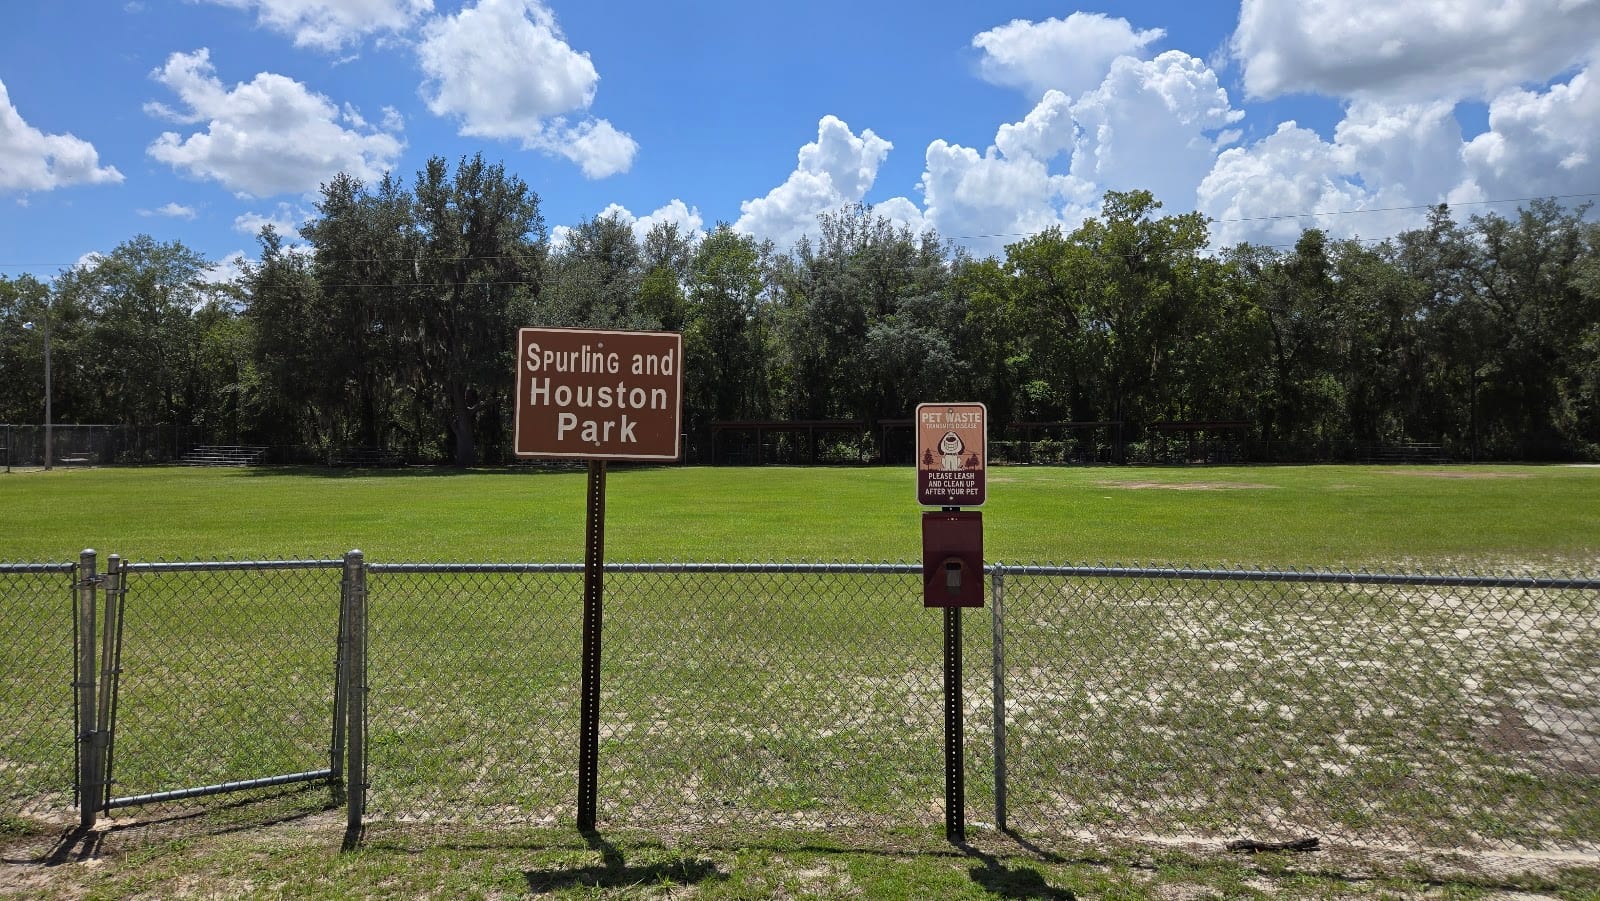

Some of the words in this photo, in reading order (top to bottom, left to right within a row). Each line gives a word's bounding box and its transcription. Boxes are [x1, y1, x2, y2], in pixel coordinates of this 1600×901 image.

[631, 348, 674, 376] and
[530, 377, 667, 410] Houston
[922, 412, 942, 423] PET
[945, 412, 982, 423] WASTE
[557, 412, 638, 443] Park
[928, 472, 953, 480] PLEASE
[954, 472, 975, 480] LEASH
[928, 480, 942, 488] AND
[943, 480, 965, 488] CLEAN
[966, 480, 975, 488] UP
